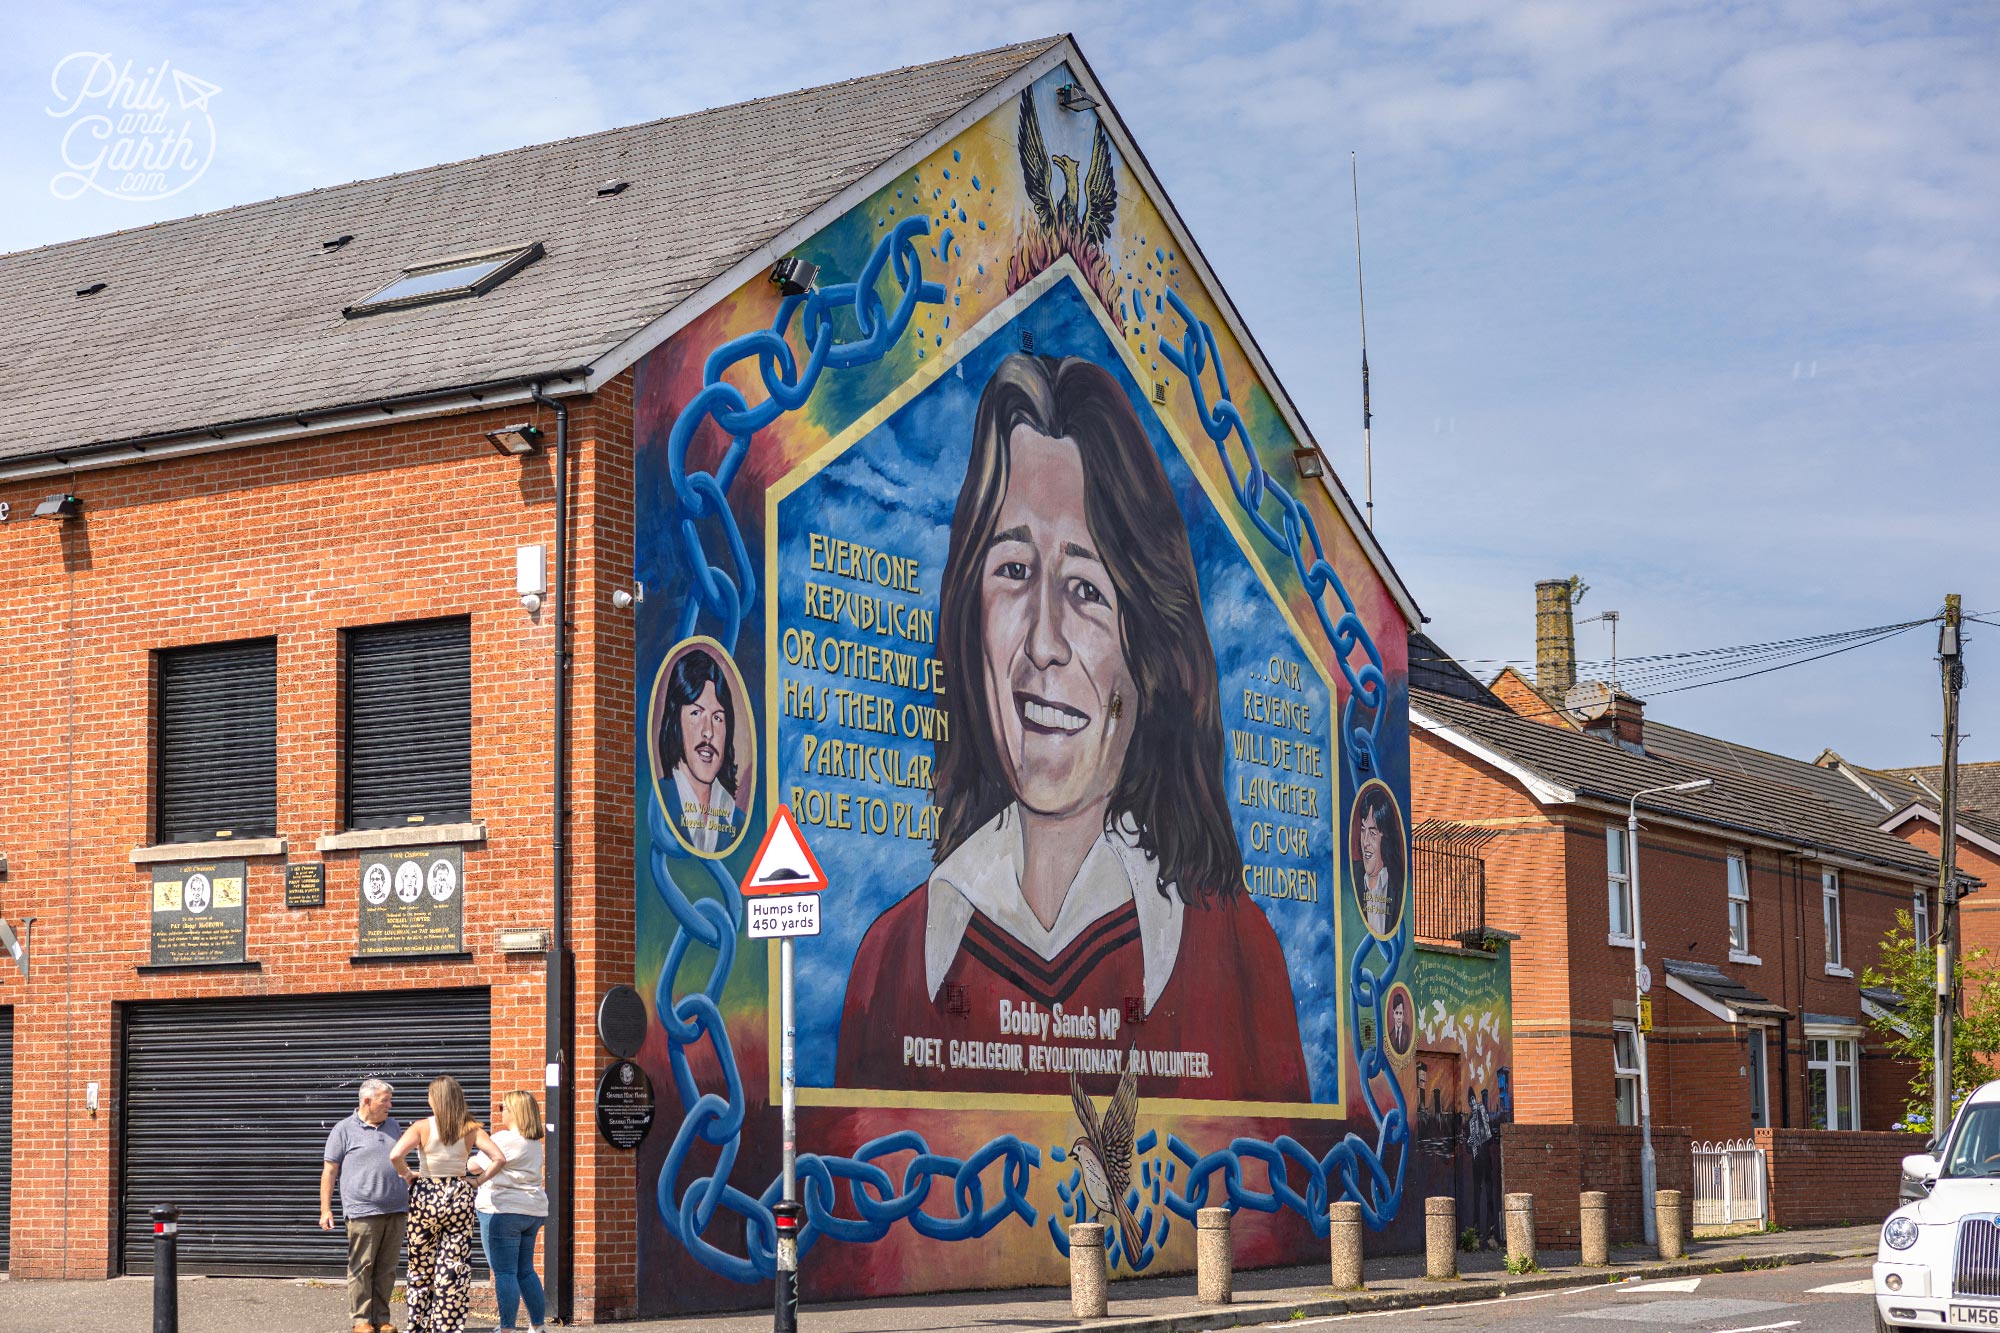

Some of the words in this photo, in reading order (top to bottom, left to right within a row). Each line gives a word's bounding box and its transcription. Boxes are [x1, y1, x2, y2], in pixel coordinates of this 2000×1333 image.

[809, 532, 922, 594] EVERYONE
[804, 581, 935, 645] REPUBLICAN
[782, 627, 817, 671] OR
[820, 637, 946, 695] OTHERWISE
[784, 677, 829, 723] HAS
[834, 688, 897, 736] THEIR
[901, 703, 950, 743] OWN
[1243, 688, 1311, 735] REVENGE
[804, 734, 935, 790] PARTICULAR
[1232, 729, 1269, 767] WILL
[1271, 737, 1293, 771] BE
[1294, 741, 1323, 778] THE
[790, 785, 852, 831] ROLE
[856, 796, 888, 835] TO
[892, 801, 944, 841] PLAY
[1238, 775, 1319, 820] LAUGHTER
[1250, 820, 1273, 852] OF
[1276, 824, 1310, 859] OUR
[1241, 864, 1319, 904] CHILDREN
[753, 904, 794, 916] Humps
[797, 901, 814, 913] for
[753, 918, 778, 931] 450
[781, 916, 814, 931] yards
[999, 999, 1049, 1041] Bobby
[1052, 1002, 1097, 1040] Sands
[1098, 1008, 1121, 1041] MP
[903, 1036, 946, 1072] POET,
[949, 1040, 1028, 1076] GAEILGEOIR,
[1149, 1050, 1213, 1078] VOLUNTEER.
[1957, 1307, 1999, 1325] LM56
